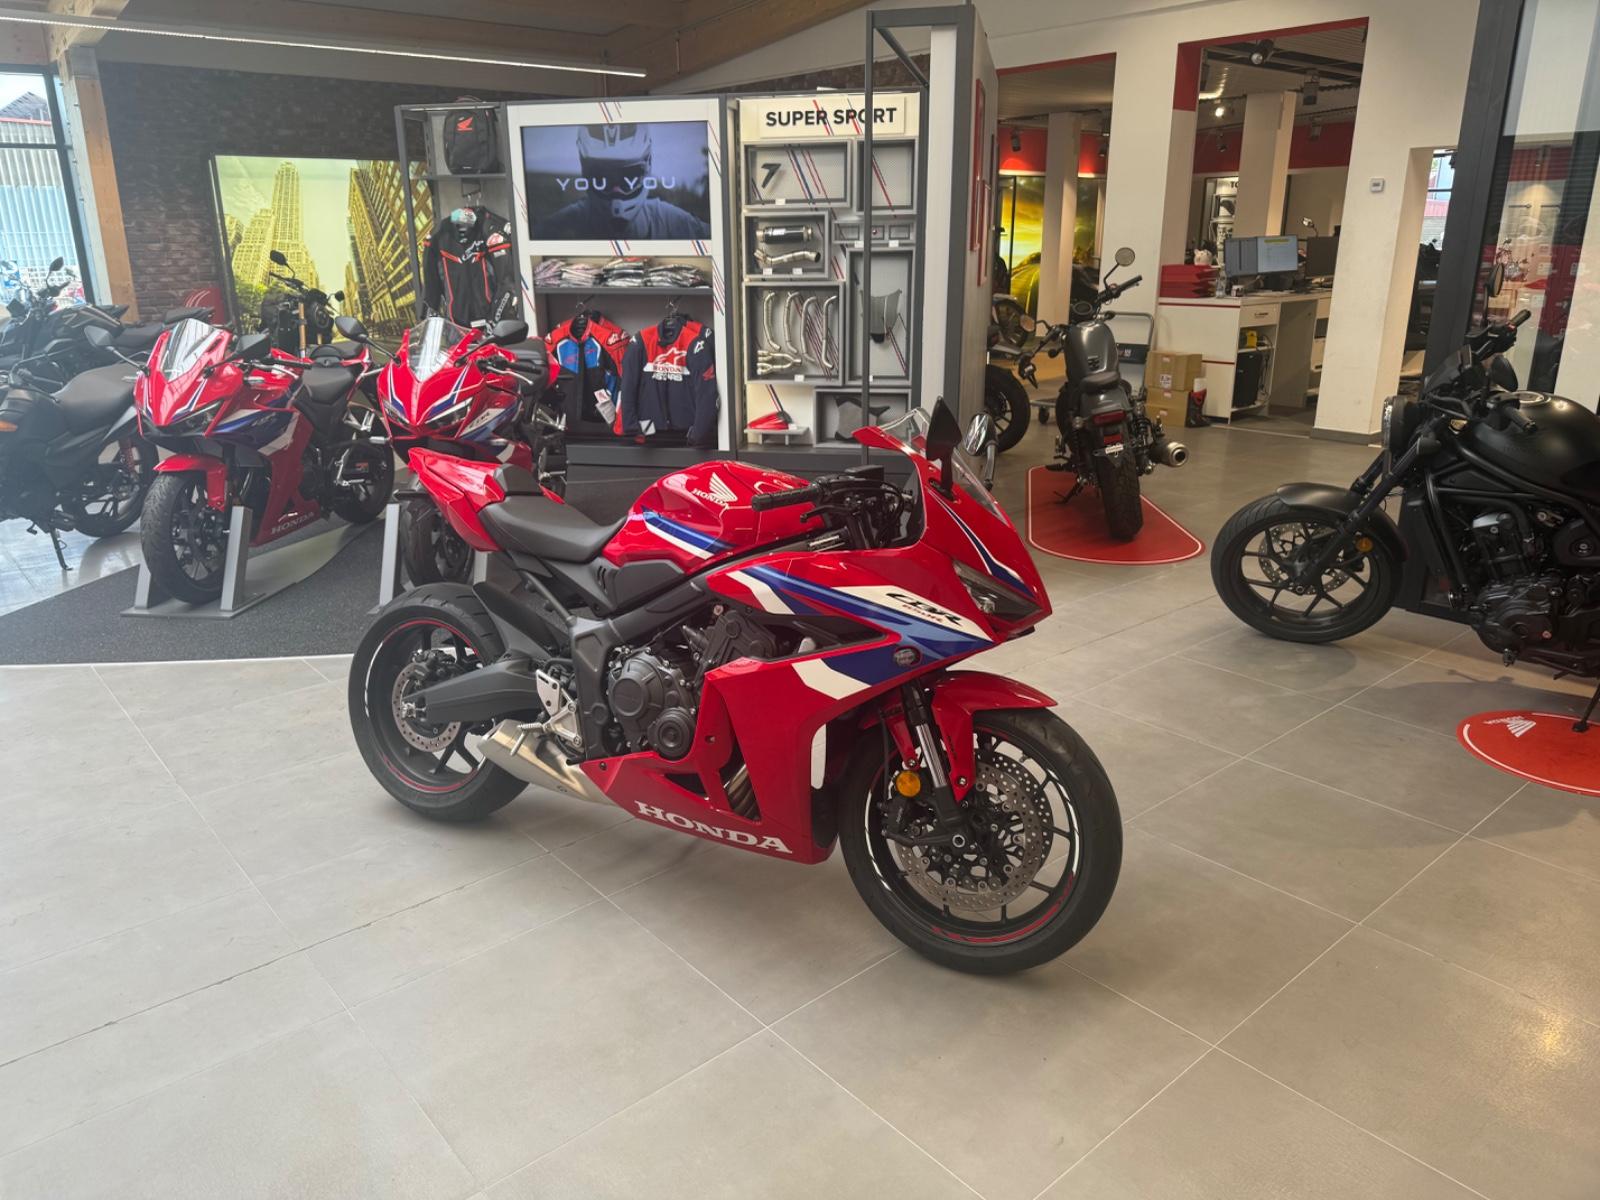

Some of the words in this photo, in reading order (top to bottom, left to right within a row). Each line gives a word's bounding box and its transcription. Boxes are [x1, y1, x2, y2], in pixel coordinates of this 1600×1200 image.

[766, 110, 828, 127] SUPER
[556, 177, 607, 191] YOU
[623, 176, 676, 190] YOU
[691, 488, 728, 507] HONDA
[634, 800, 793, 854] HONDA
